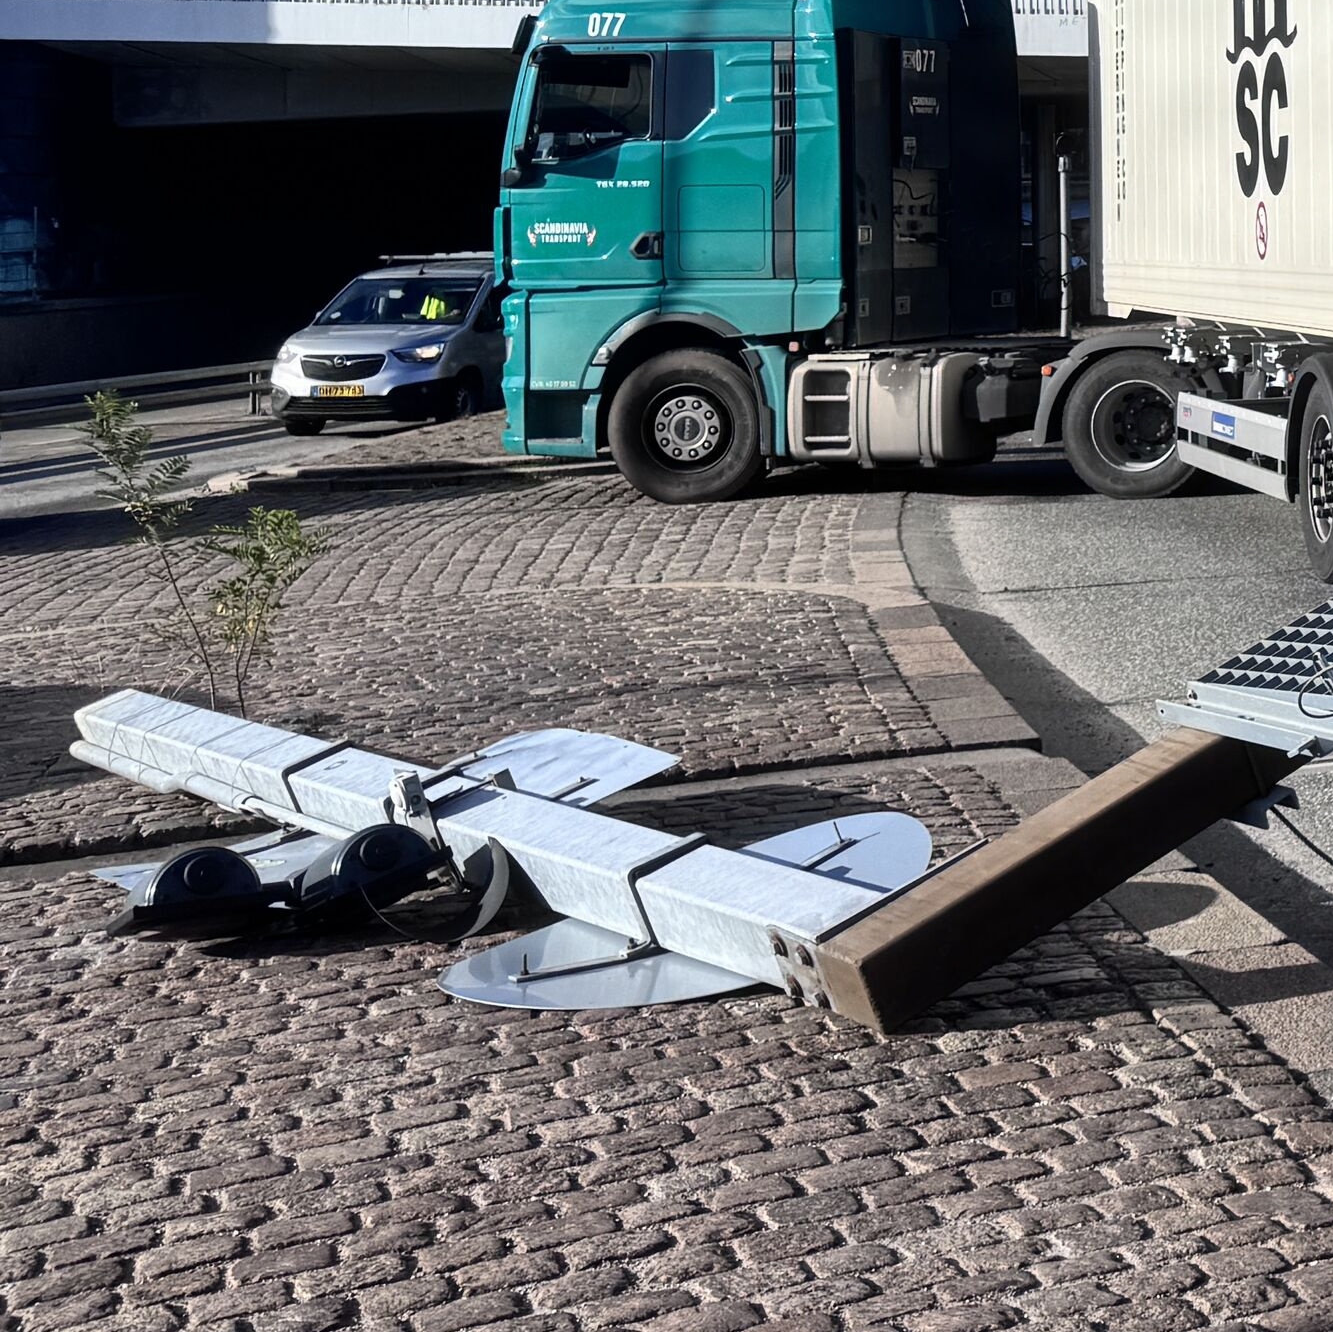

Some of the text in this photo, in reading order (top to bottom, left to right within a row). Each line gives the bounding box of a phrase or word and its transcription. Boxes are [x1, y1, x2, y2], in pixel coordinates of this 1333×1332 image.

[587, 12, 627, 37] 077
[915, 49, 936, 73] 077
[533, 221, 589, 235] SCANDINAVIA
[541, 234, 582, 244] TRANSPORT
